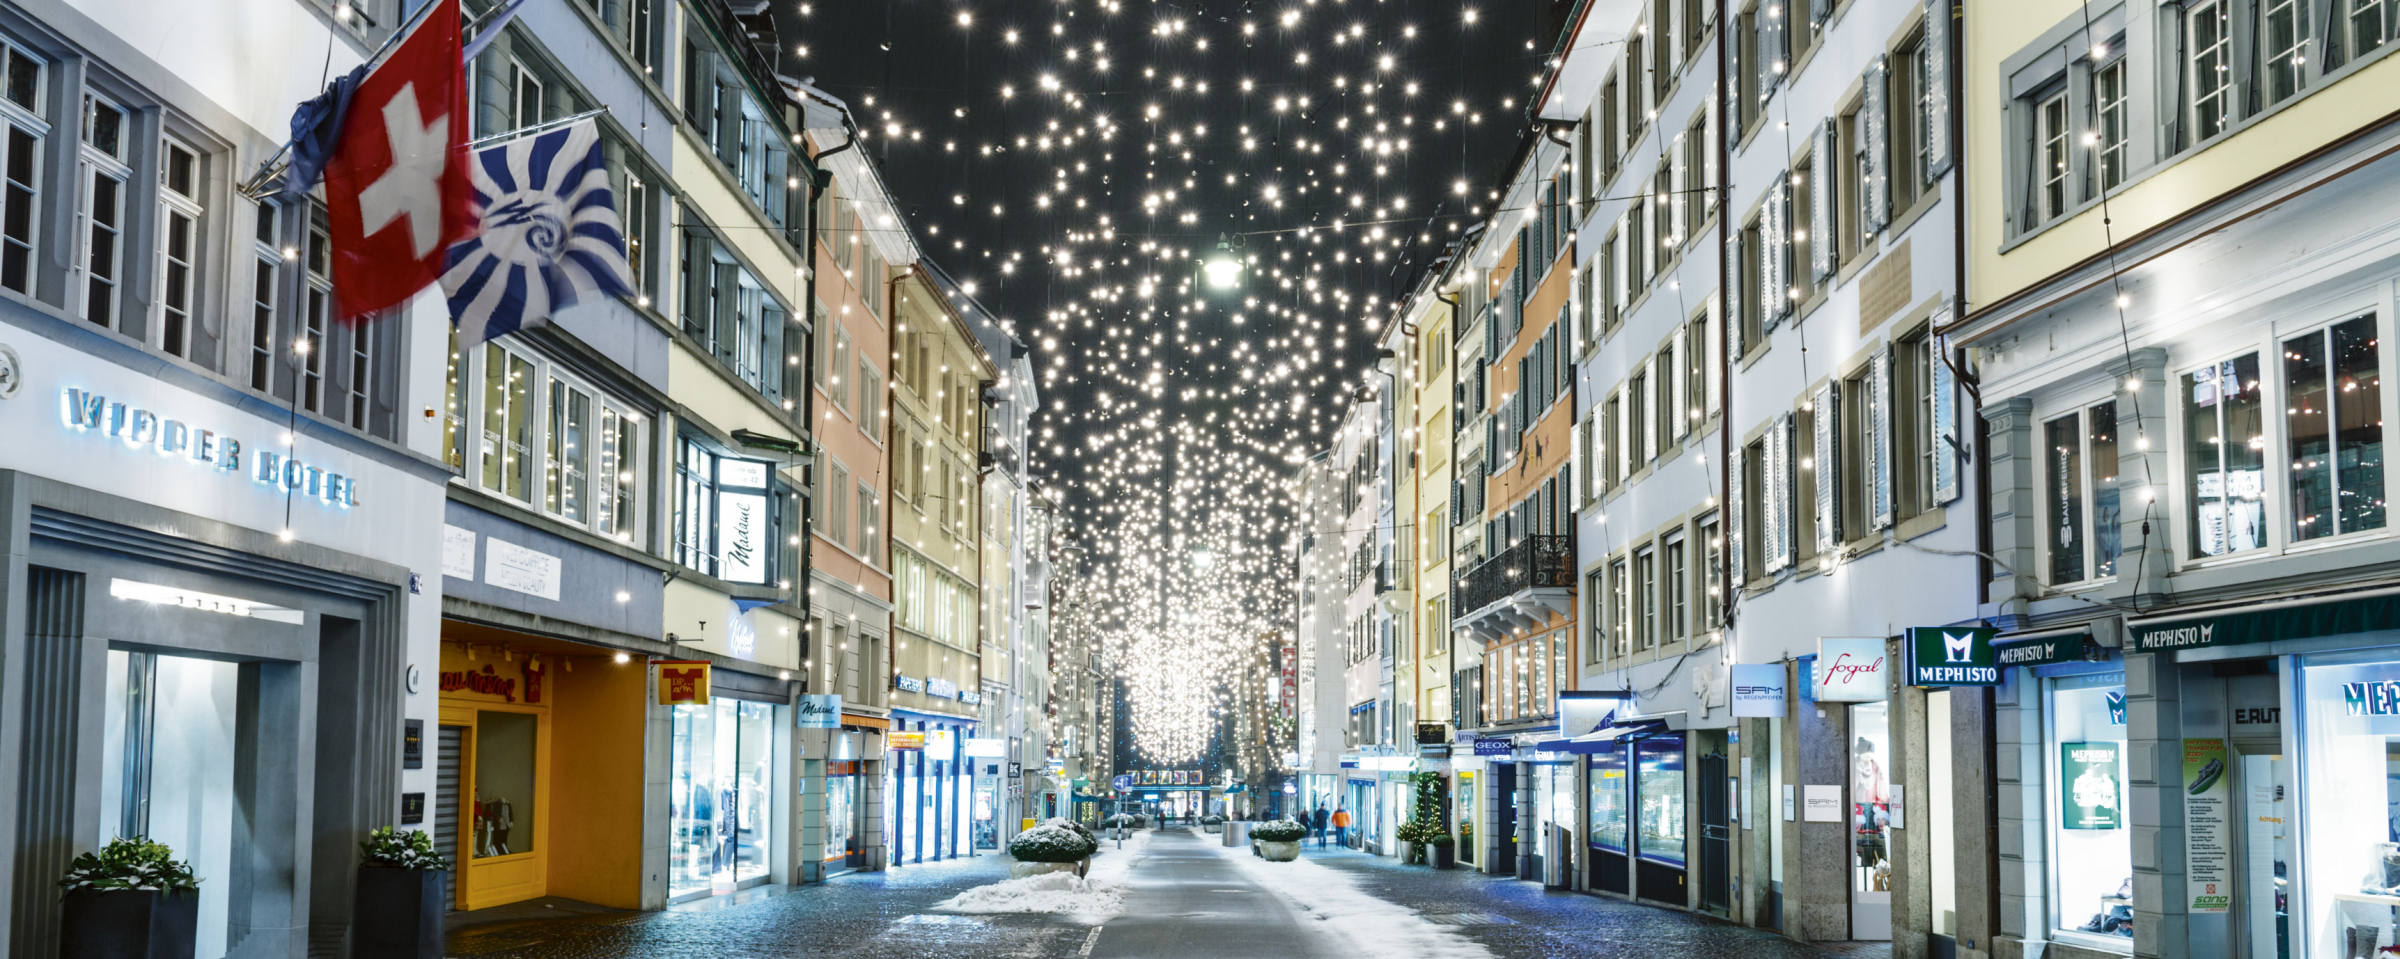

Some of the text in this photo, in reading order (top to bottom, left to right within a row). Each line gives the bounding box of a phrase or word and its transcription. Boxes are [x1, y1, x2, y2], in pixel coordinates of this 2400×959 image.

[68, 388, 360, 506] WIDDER HOTEL
[2061, 452, 2069, 525] BAUERFEIND
[2141, 626, 2198, 648] MEPHISTO
[1999, 645, 2043, 664] MEPHISTO
[1823, 653, 1883, 685] fogal
[1919, 667, 1997, 682] MEPHISTO
[1736, 686, 1783, 695] SAM
[1567, 717, 1601, 728] JOHN
[1475, 741, 1511, 749] GEOX
[2259, 816, 2281, 824] Achtung
